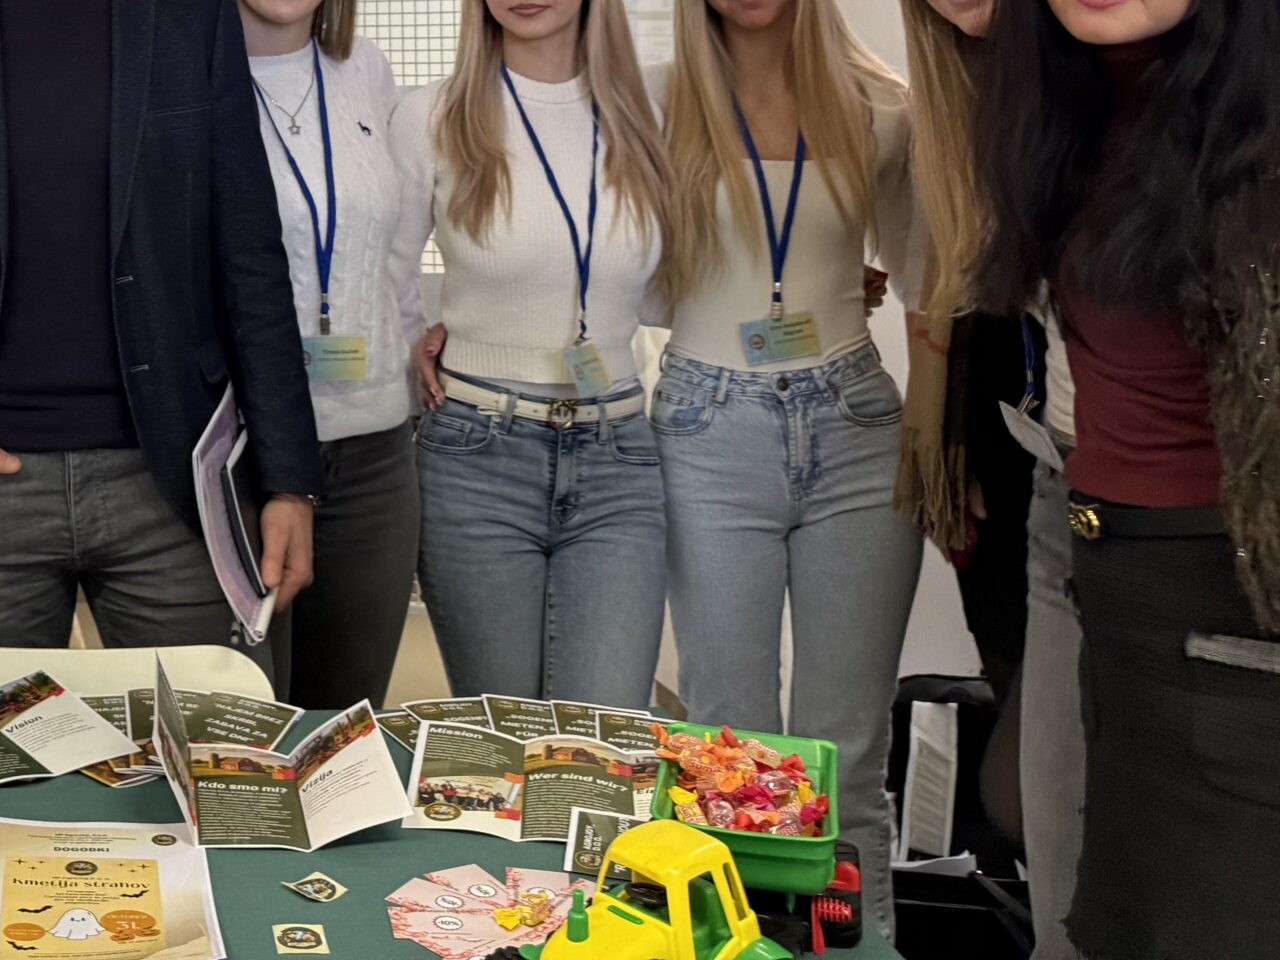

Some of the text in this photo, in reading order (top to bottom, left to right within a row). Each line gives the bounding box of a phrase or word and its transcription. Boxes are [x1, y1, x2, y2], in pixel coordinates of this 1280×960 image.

[5, 715, 43, 733] Vision
[254, 713, 285, 724] BREZ
[204, 718, 268, 738] ZABAVA ZA
[207, 726, 227, 736] VSE
[429, 727, 483, 740] Mission
[198, 781, 227, 790] Kdo
[262, 785, 288, 794] mi?
[302, 769, 333, 793] Vizija
[528, 773, 628, 792] Wer sind wir?
[13, 878, 150, 889] Kmetija strahov
